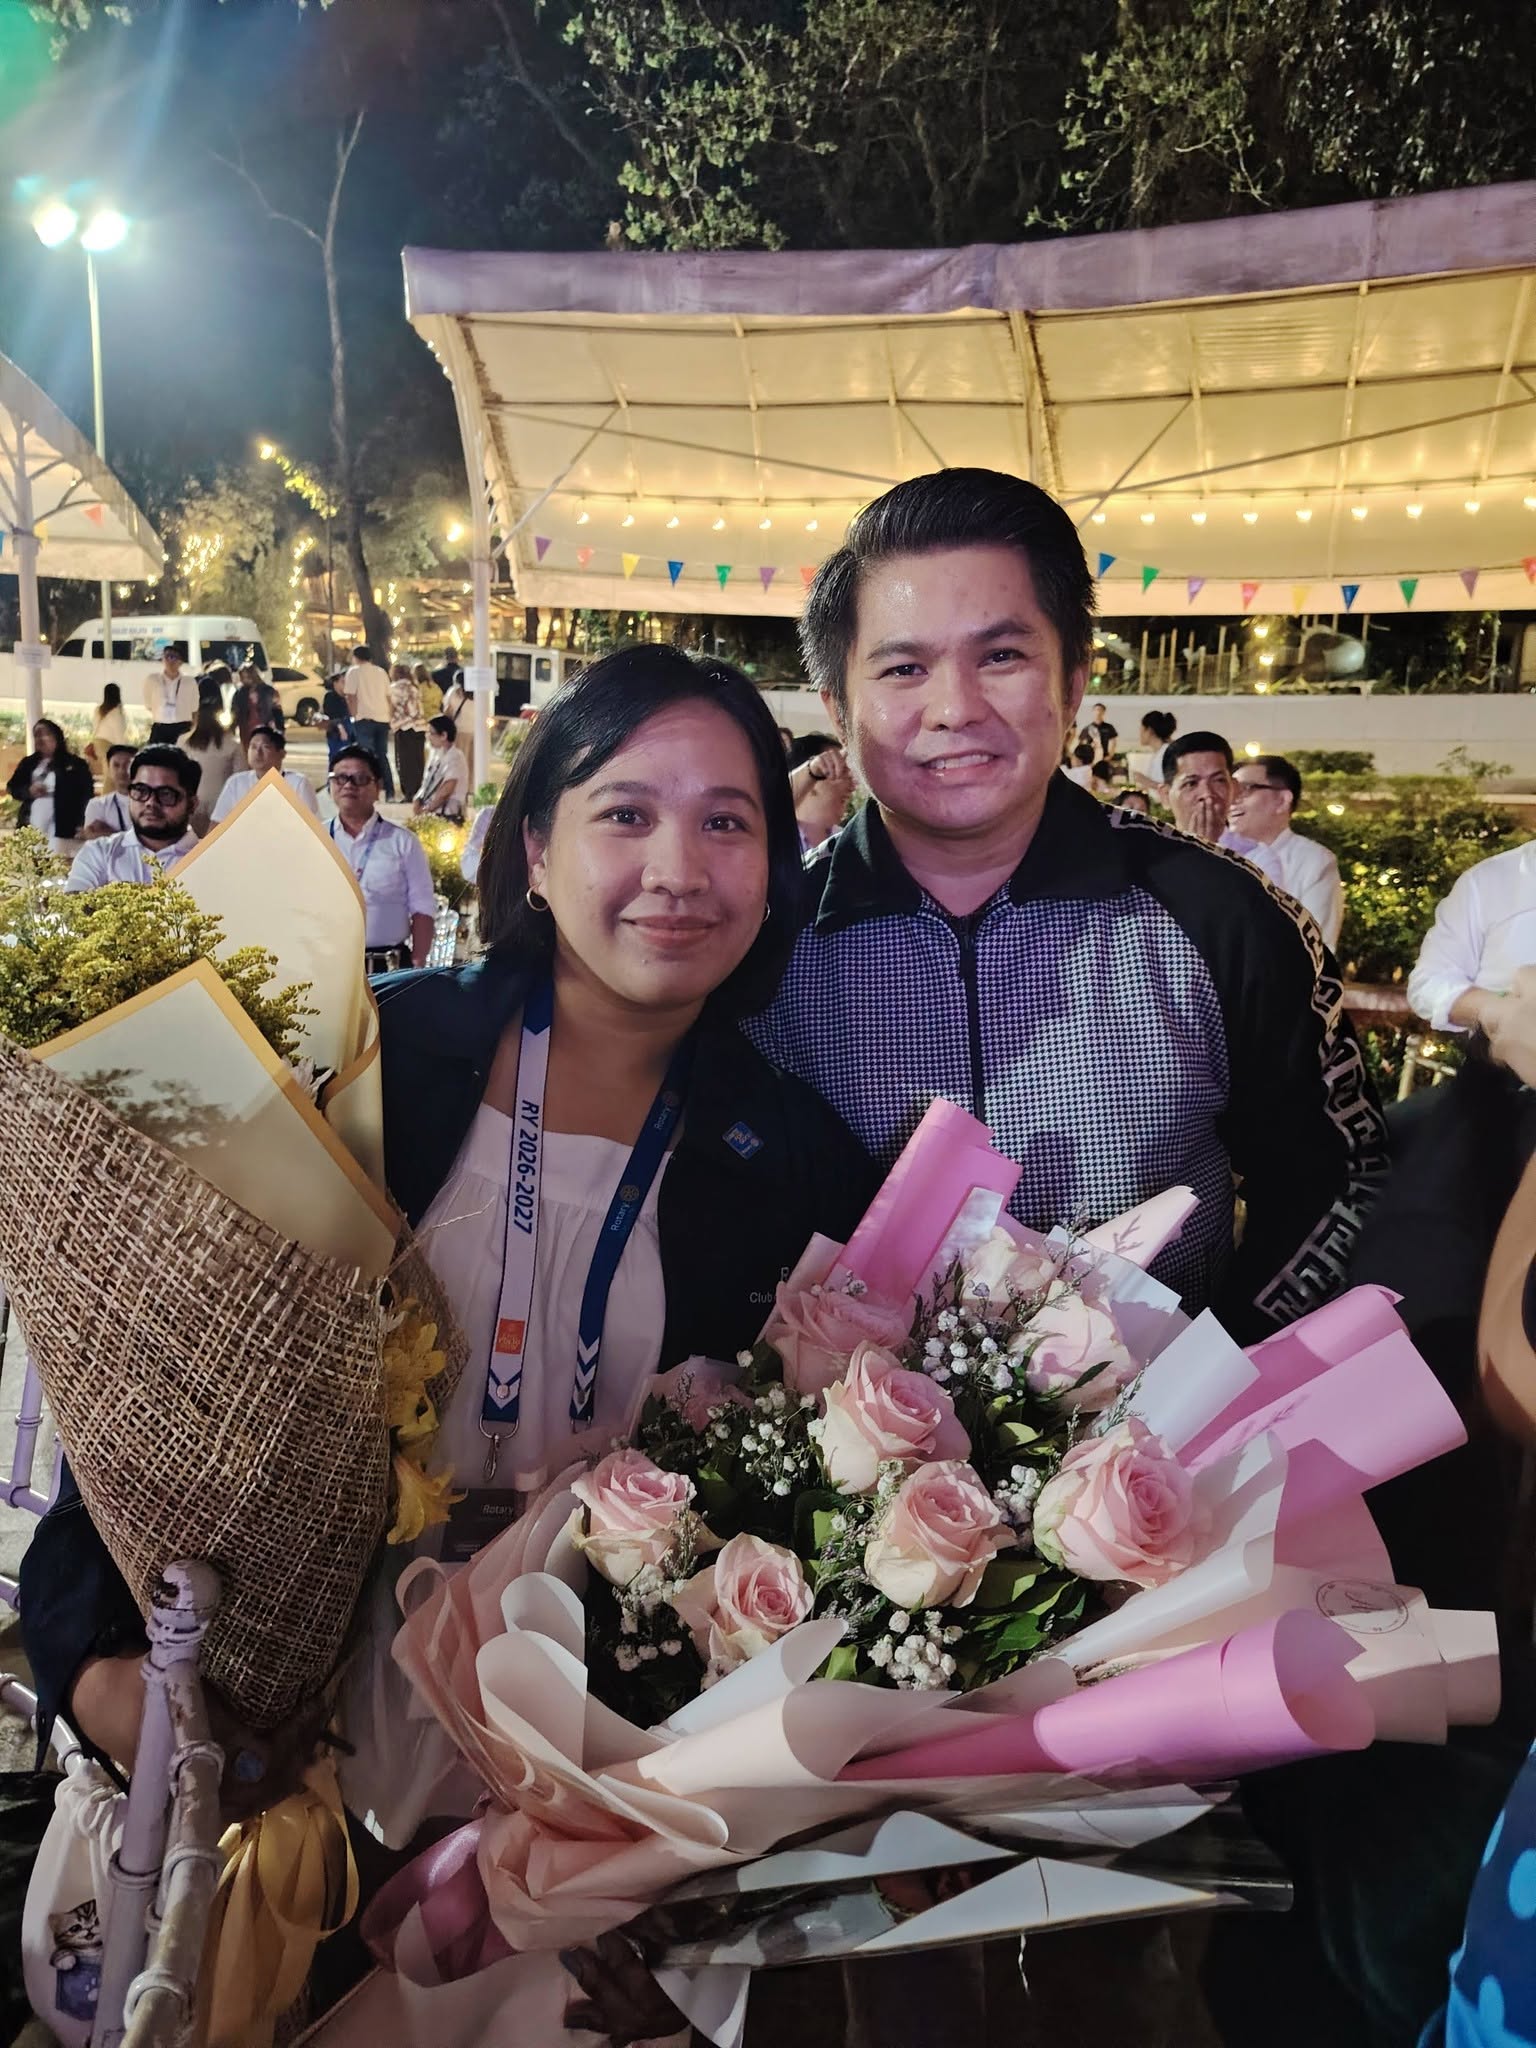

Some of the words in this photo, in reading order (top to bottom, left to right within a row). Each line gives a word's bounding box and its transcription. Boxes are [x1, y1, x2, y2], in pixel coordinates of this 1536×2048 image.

[521, 1100, 540, 1128] RY
[513, 1129, 539, 1235] 2026-2027
[610, 1203, 630, 1231] Rotary
[749, 1291, 773, 1304] Club
[482, 1504, 514, 1516] Rotary
